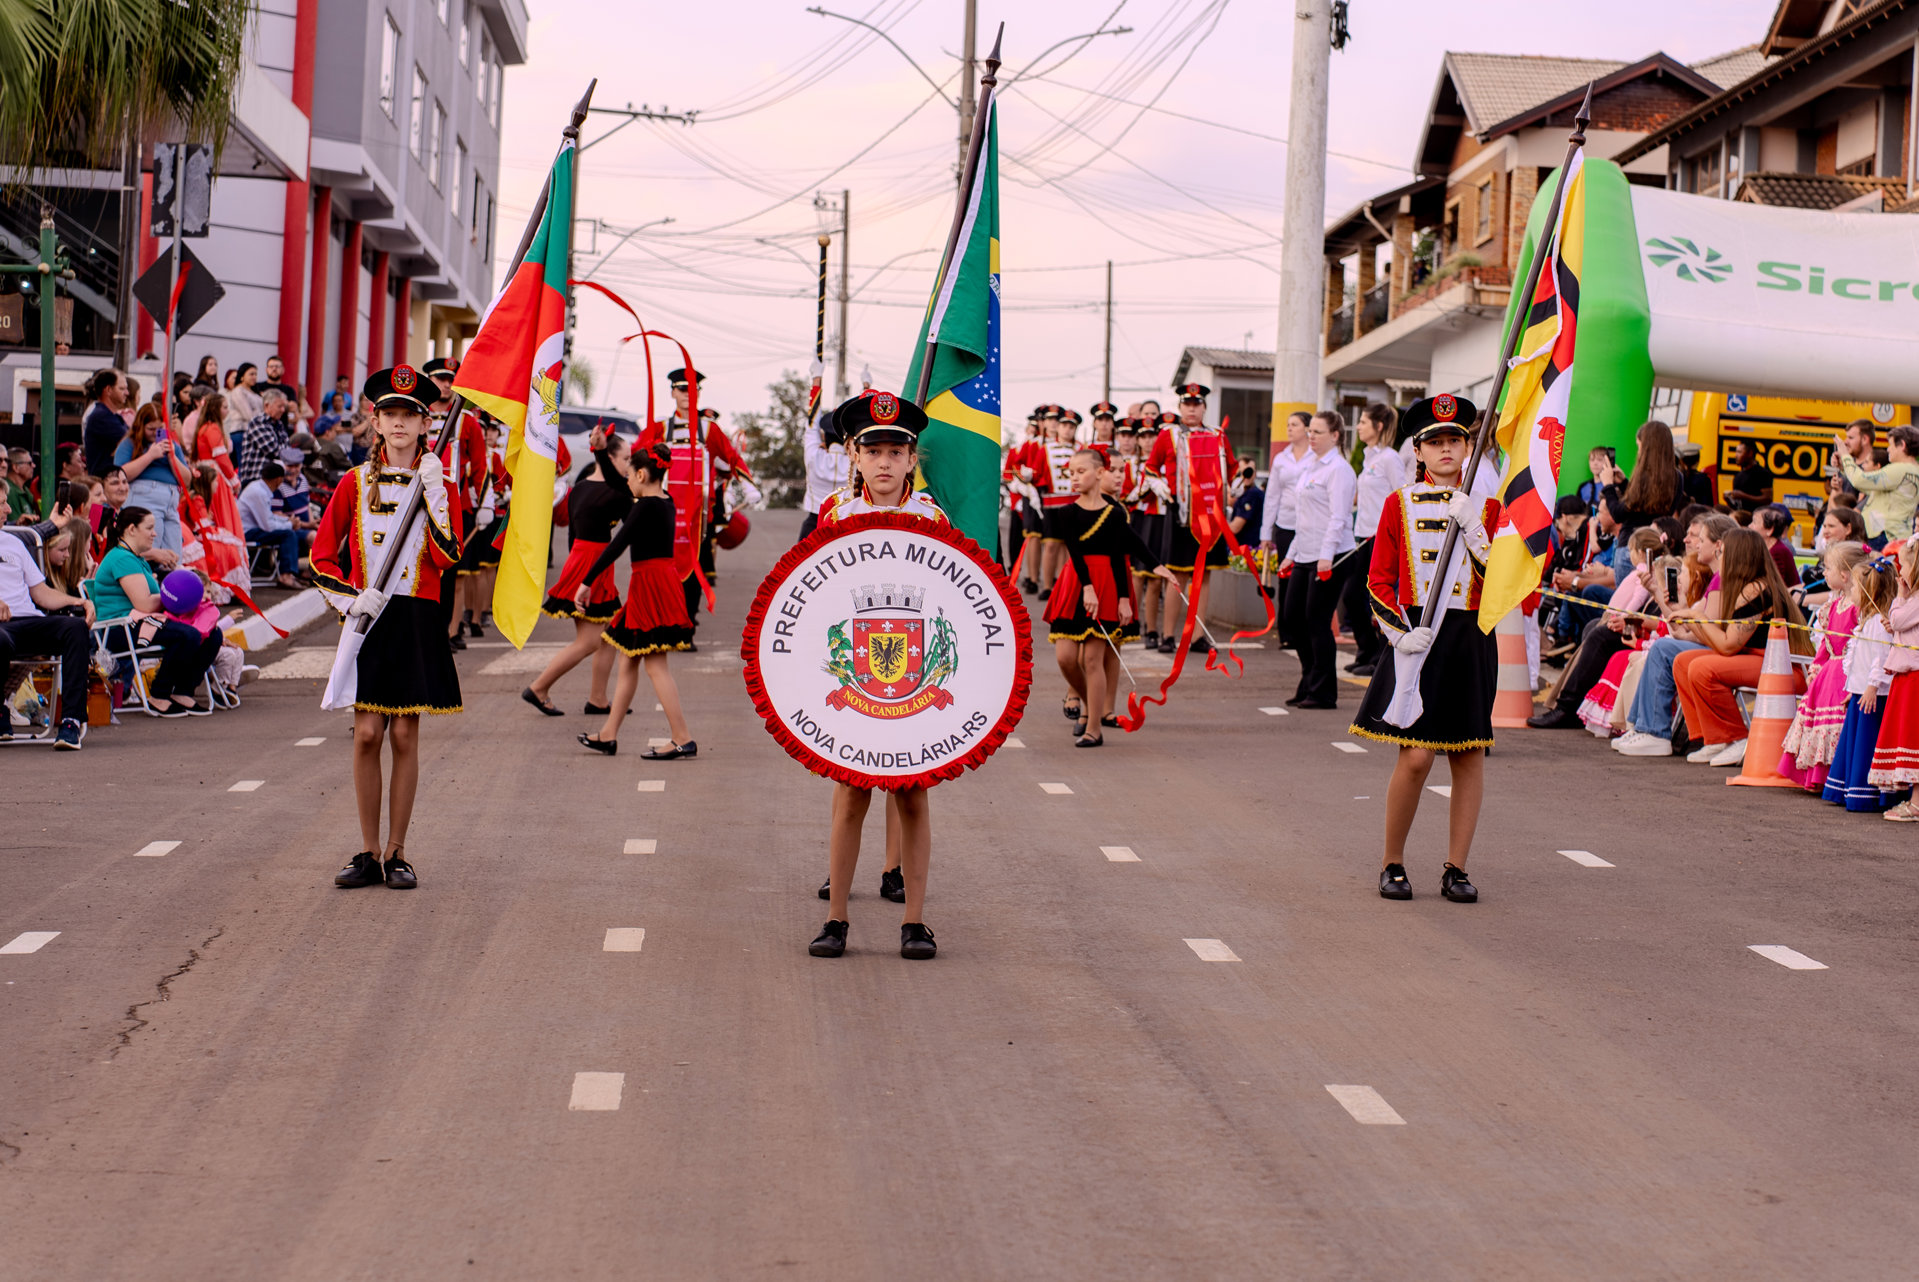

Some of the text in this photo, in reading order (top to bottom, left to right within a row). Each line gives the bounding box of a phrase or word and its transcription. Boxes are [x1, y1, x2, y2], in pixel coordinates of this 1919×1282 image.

[1757, 261, 1919, 302] Sicr
[0, 315, 11, 329] O
[1553, 429, 1564, 465] NOVA
[772, 541, 1005, 656] PREFEITURA MUNICIPAL
[843, 690, 936, 717] NOVA CANDELÁRIA
[790, 708, 988, 768] NOVA CANDELÁRIA-RS
